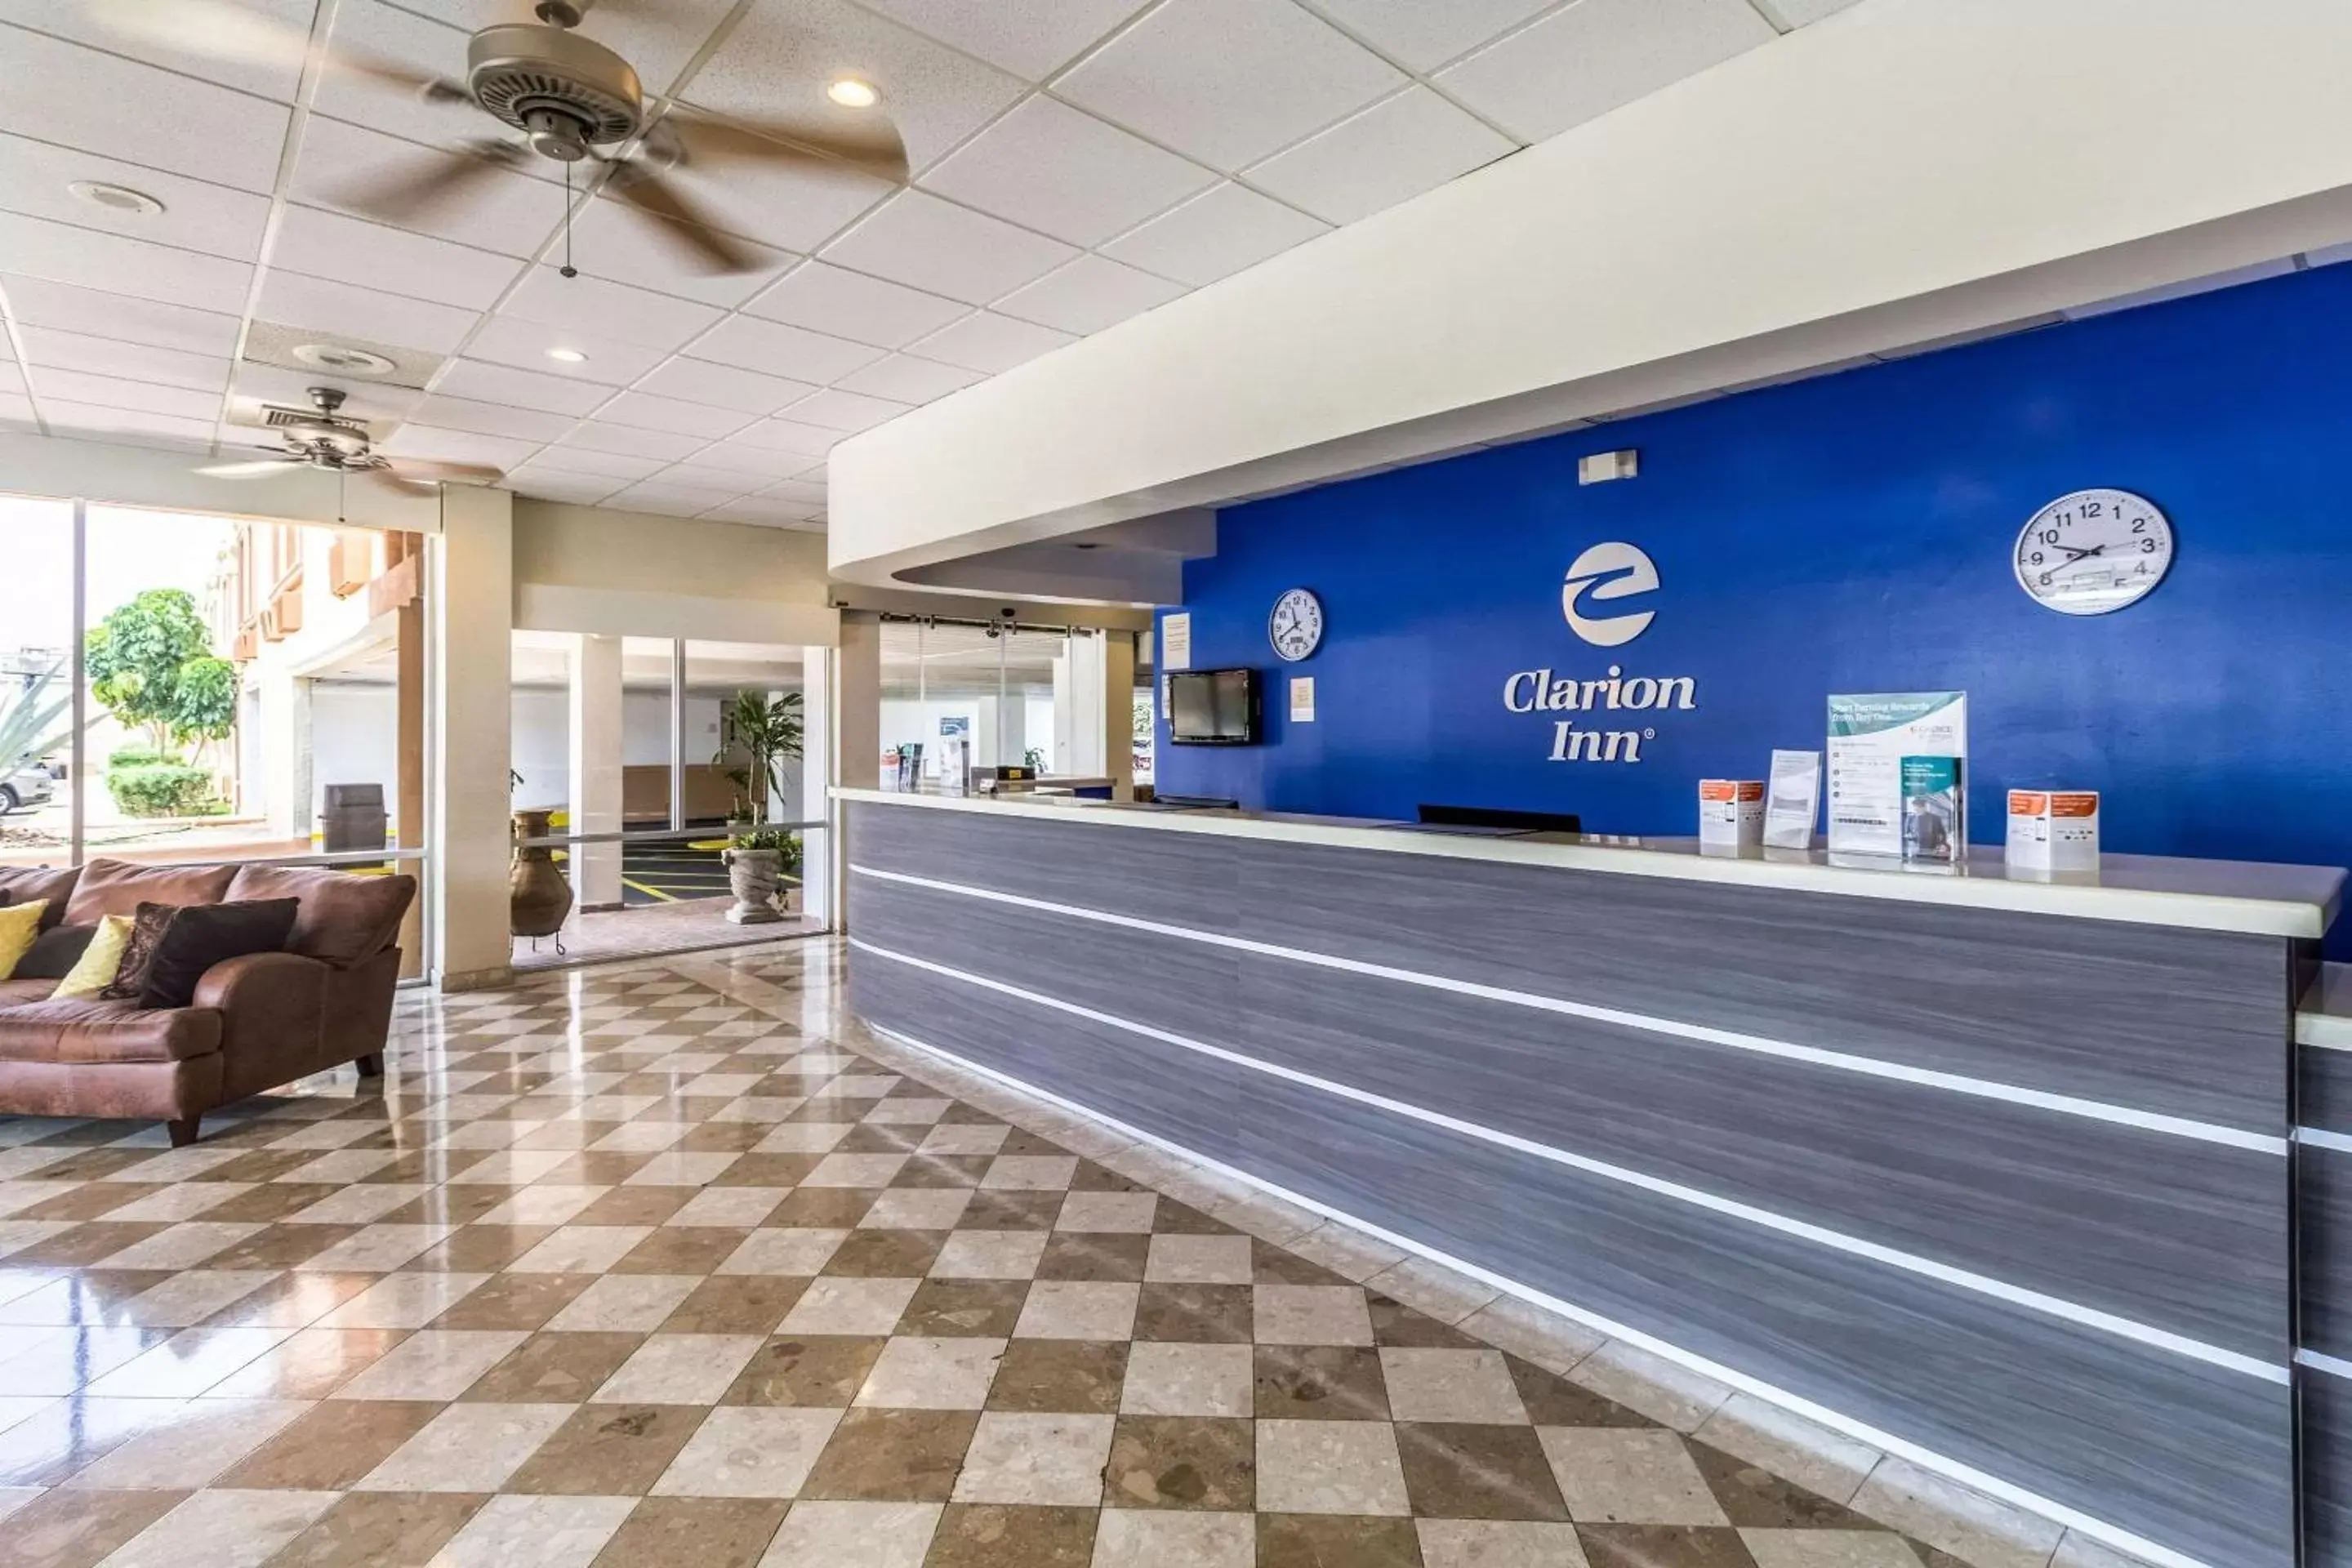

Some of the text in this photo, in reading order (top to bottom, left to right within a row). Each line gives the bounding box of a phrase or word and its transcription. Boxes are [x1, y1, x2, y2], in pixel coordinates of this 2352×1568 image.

[2079, 502, 2101, 519] 12
[2112, 506, 2121, 519] 1
[2055, 513, 2071, 528] 11
[2132, 518, 2145, 533] 2
[2038, 529, 2059, 545] 10
[2141, 537, 2155, 554] 3
[2031, 551, 2043, 566] 9
[2134, 561, 2148, 575] 4
[2039, 572, 2053, 586] 8
[1503, 665, 1696, 713] Clarion
